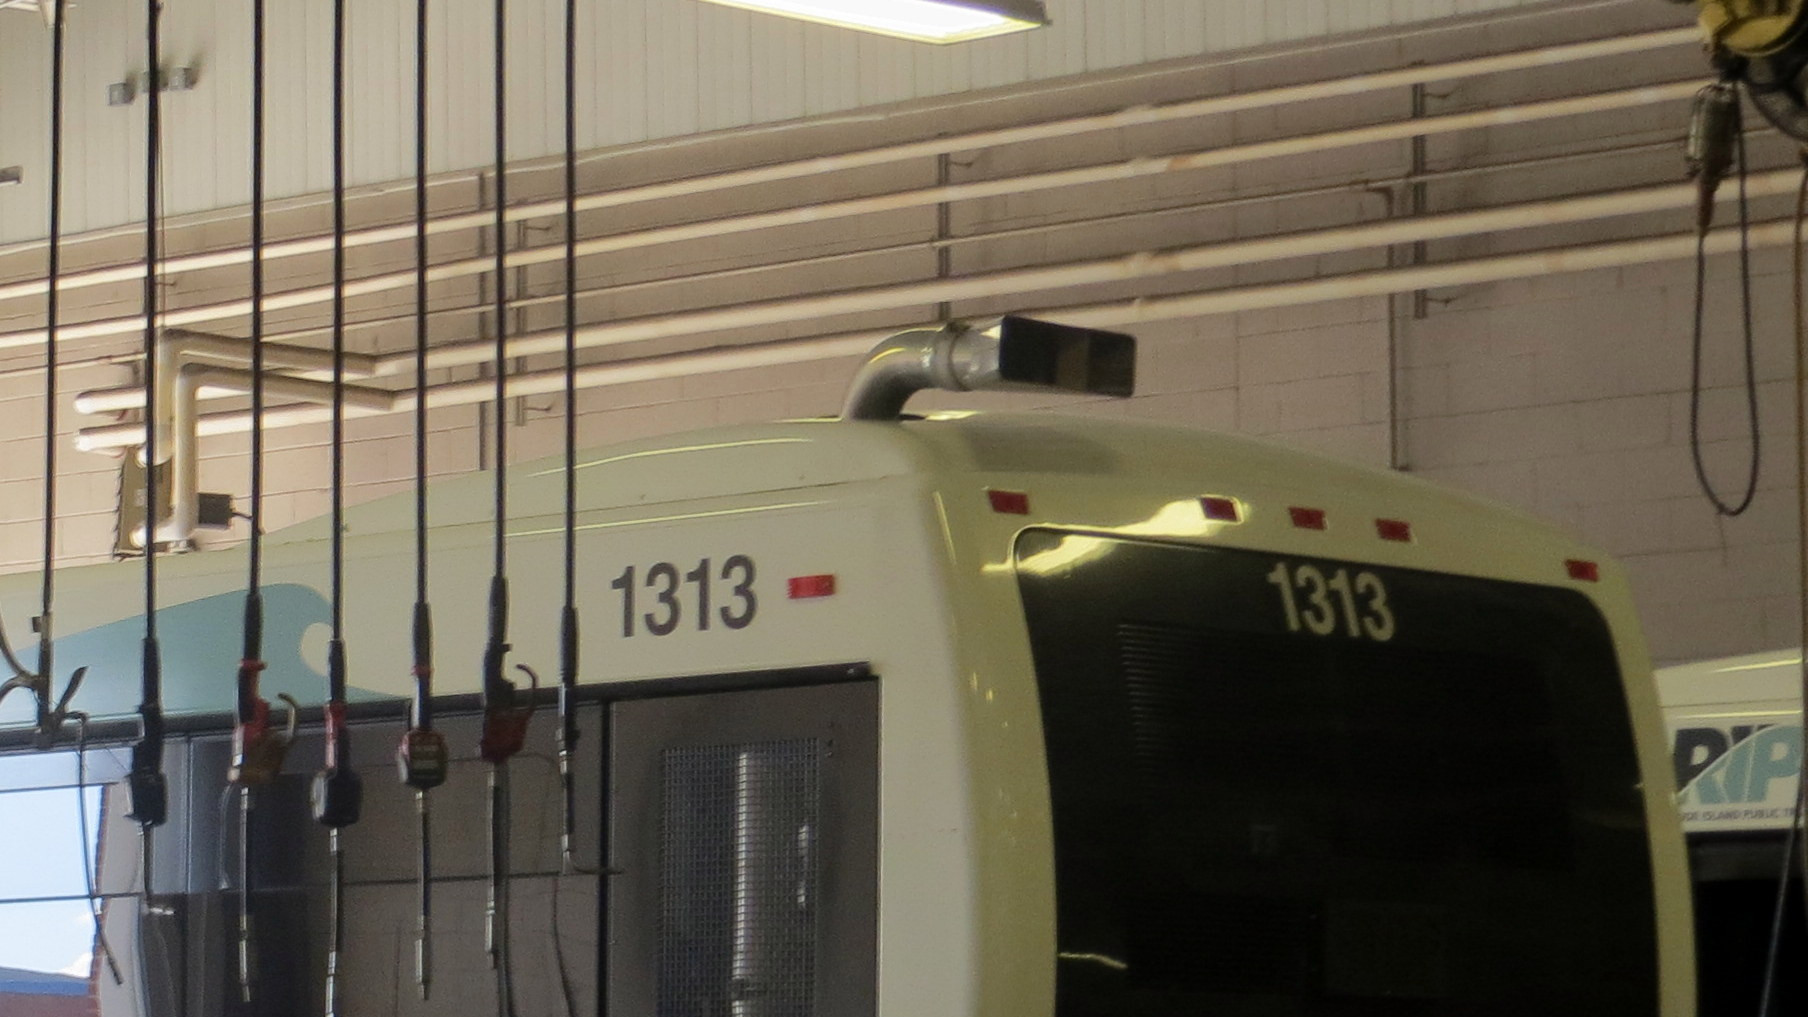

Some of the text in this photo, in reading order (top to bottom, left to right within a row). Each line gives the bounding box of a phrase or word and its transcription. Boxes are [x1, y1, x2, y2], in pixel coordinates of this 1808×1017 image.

[611, 555, 757, 637] 1313
[1266, 561, 1395, 641] 1313
[1674, 724, 1803, 804] RIP
